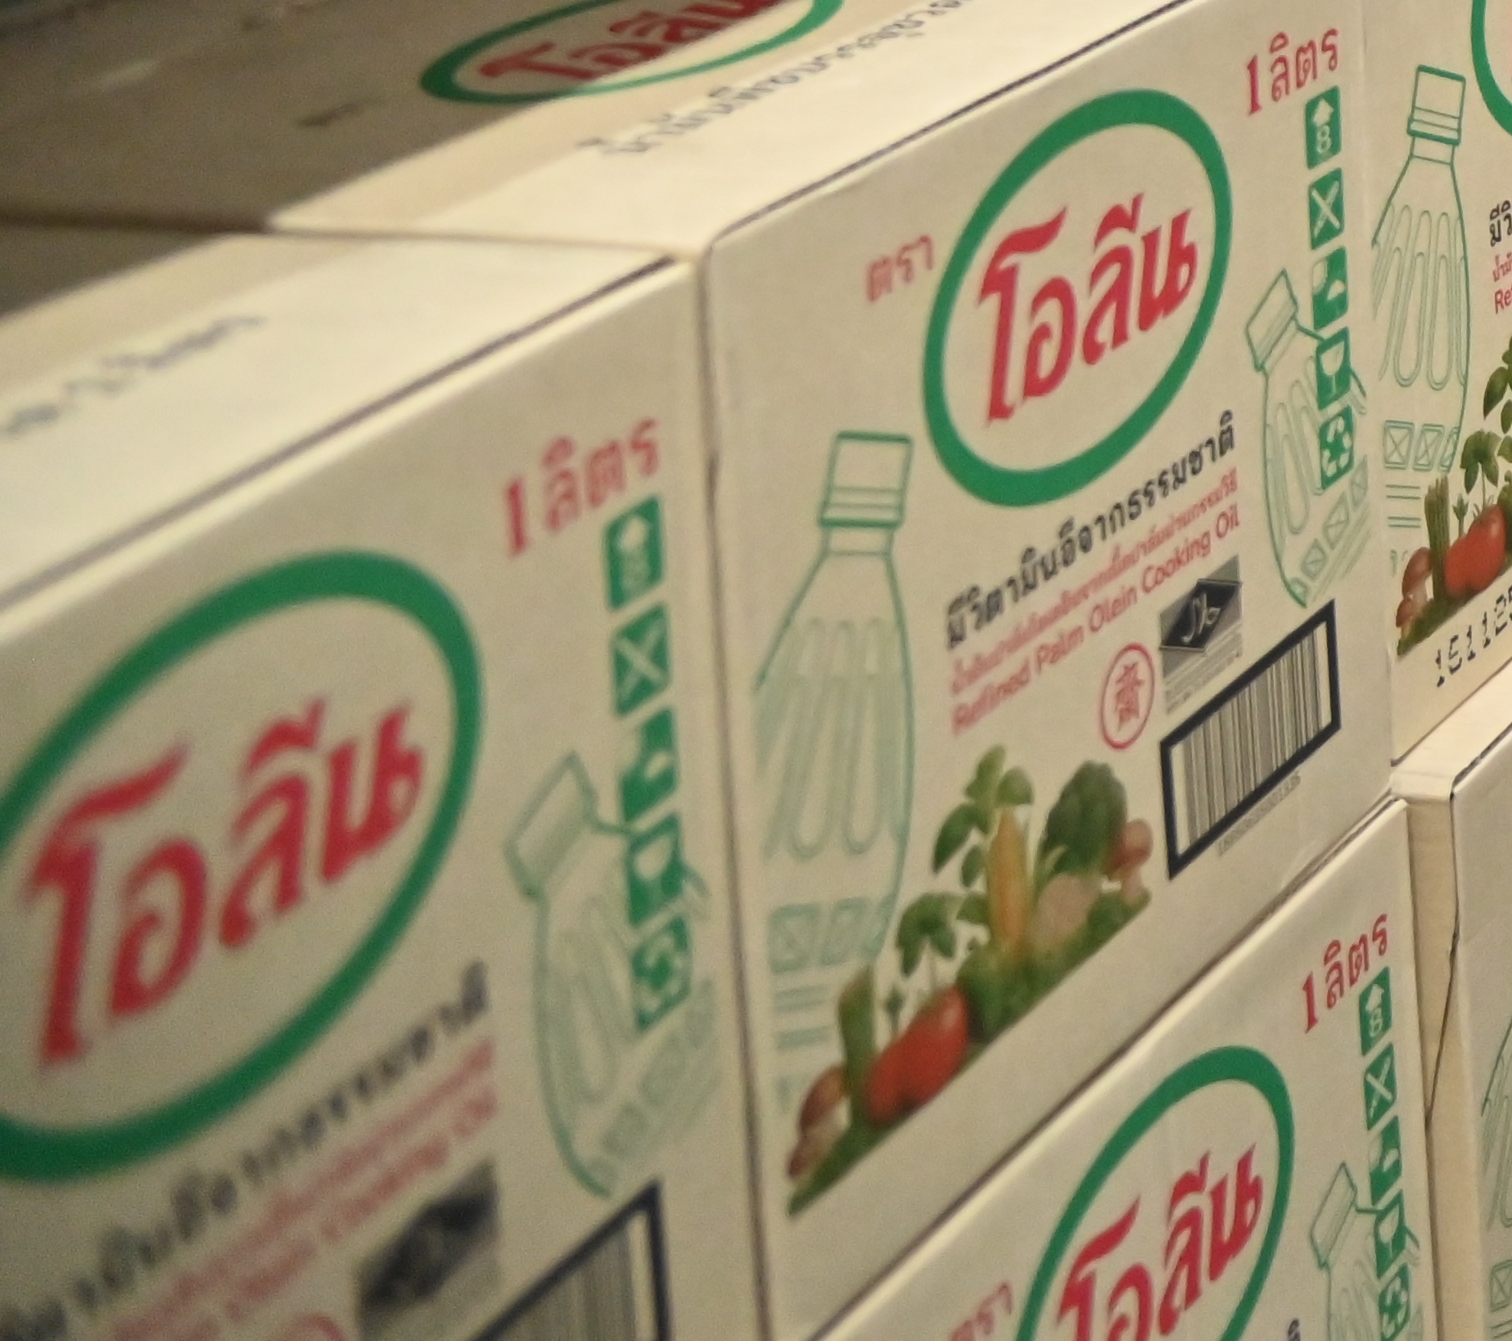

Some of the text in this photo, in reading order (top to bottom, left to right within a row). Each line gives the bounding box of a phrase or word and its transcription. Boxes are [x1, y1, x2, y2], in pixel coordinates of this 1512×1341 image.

[1245, 28, 1341, 117] 1 ลิตร
[865, 193, 1198, 425] ตรา โอลีน
[503, 420, 660, 560] 1 ลิตร
[953, 502, 1241, 737] Refined Palm Olein Cooking Oil
[26, 694, 428, 1073] โอลีน
[1301, 913, 1390, 1035] 1 ลิตร
